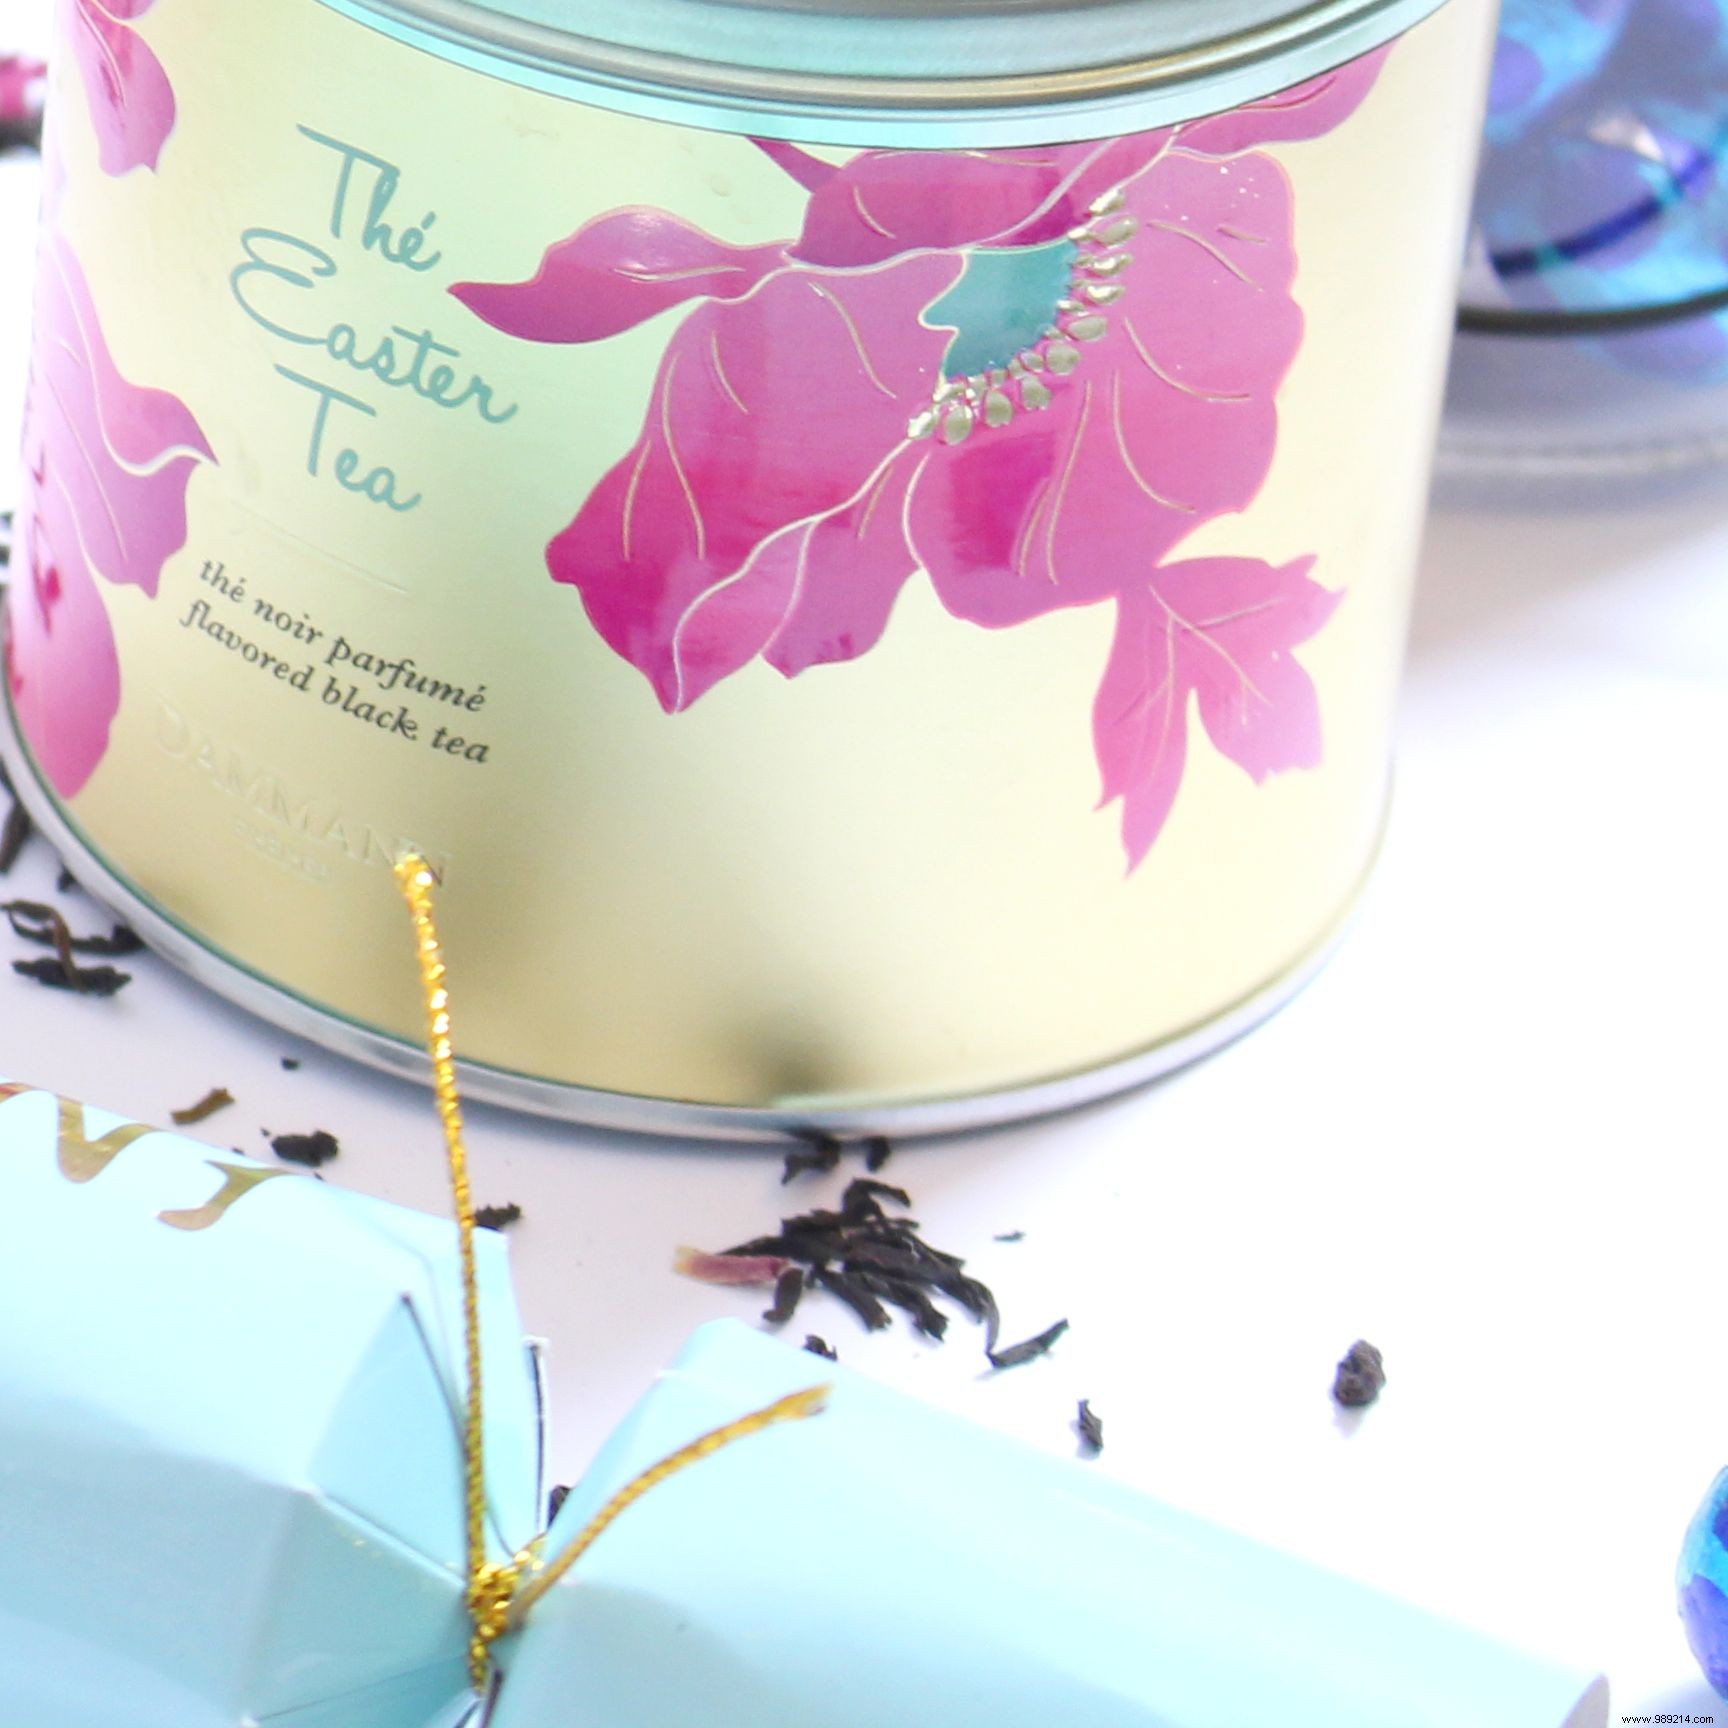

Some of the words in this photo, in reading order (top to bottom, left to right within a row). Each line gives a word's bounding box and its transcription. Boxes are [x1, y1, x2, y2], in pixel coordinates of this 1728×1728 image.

[297, 123, 441, 271] Thé
[229, 228, 518, 424] Easter
[273, 363, 422, 512] Tea
[179, 599, 316, 692] flavored
[321, 676, 419, 742] black
[430, 727, 491, 764] tea
[199, 559, 246, 603] thé
[253, 598, 324, 645] noir
[324, 636, 488, 713] parfumé
